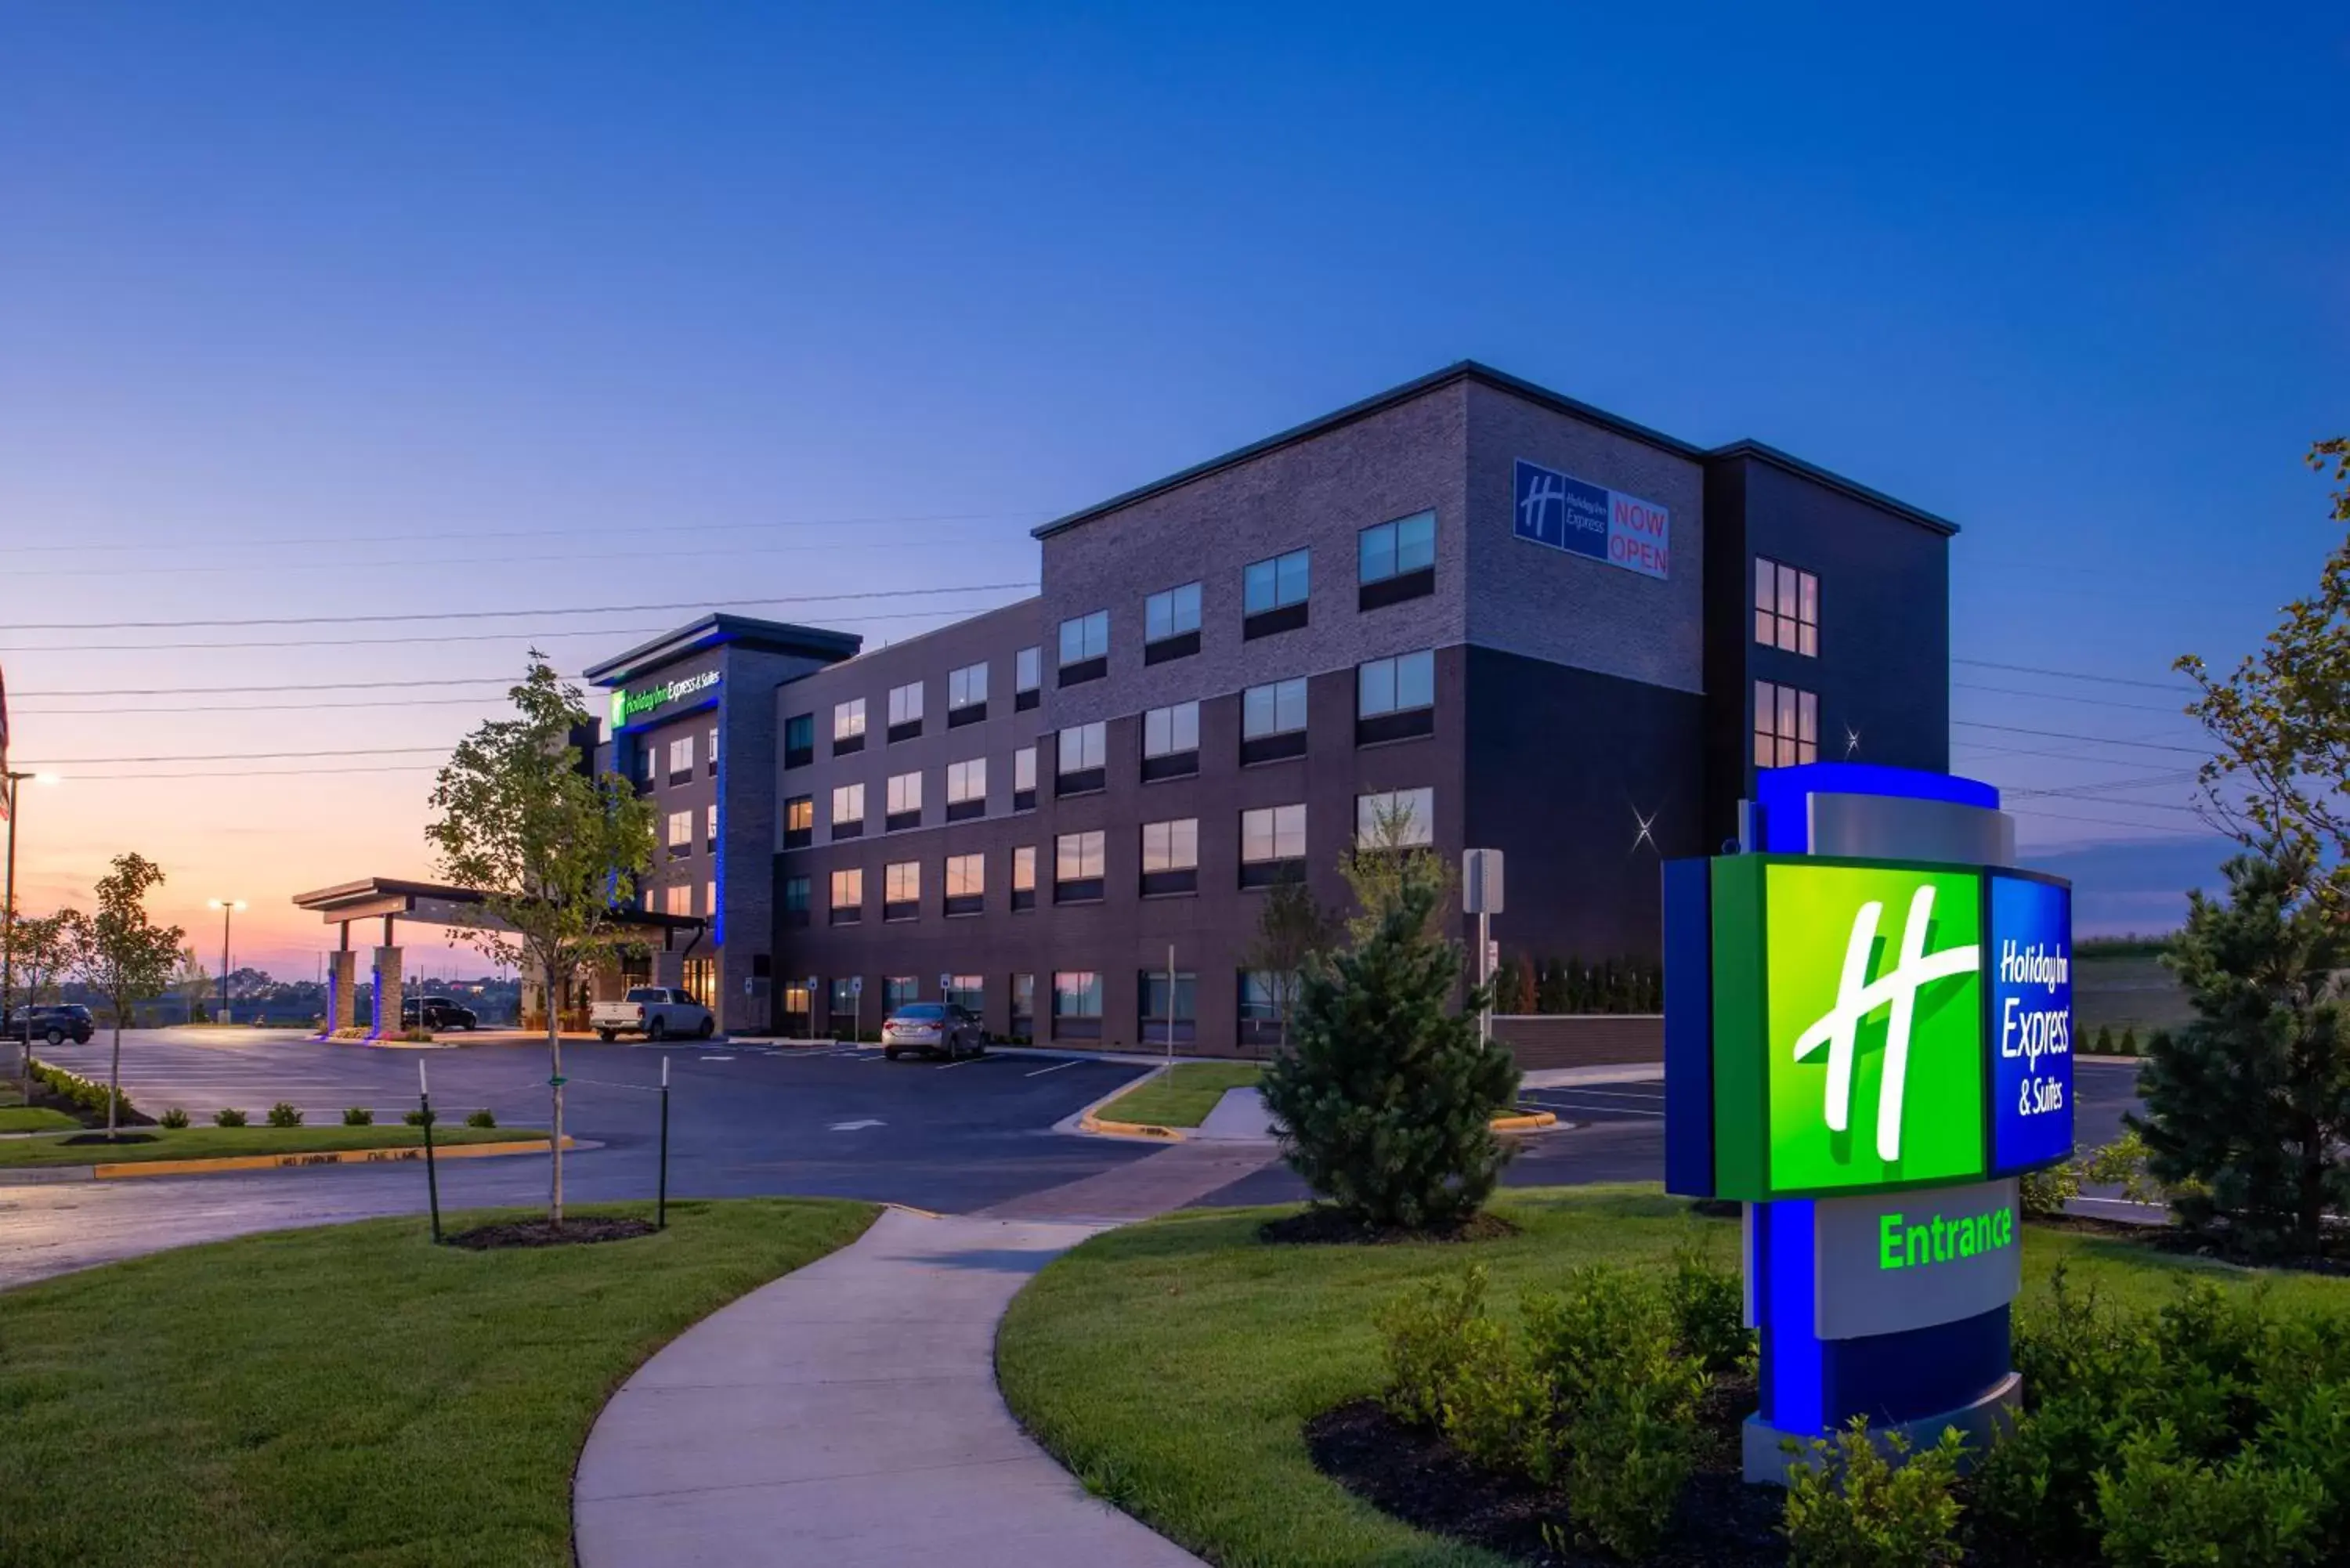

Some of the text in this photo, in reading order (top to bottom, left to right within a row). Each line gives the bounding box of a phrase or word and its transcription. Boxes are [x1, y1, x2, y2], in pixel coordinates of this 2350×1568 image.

[1567, 508, 1605, 533] Express
[1615, 499, 1665, 538] NOW
[1611, 534, 1668, 573] OPEN
[668, 677, 696, 702] Express
[695, 676, 702, 690] &
[701, 670, 720, 688] Suites
[2000, 939, 2055, 994] Holiday
[2002, 997, 2069, 1073] Express
[2019, 1076, 2063, 1116] & Suites
[1879, 1207, 2011, 1270] Entrance
